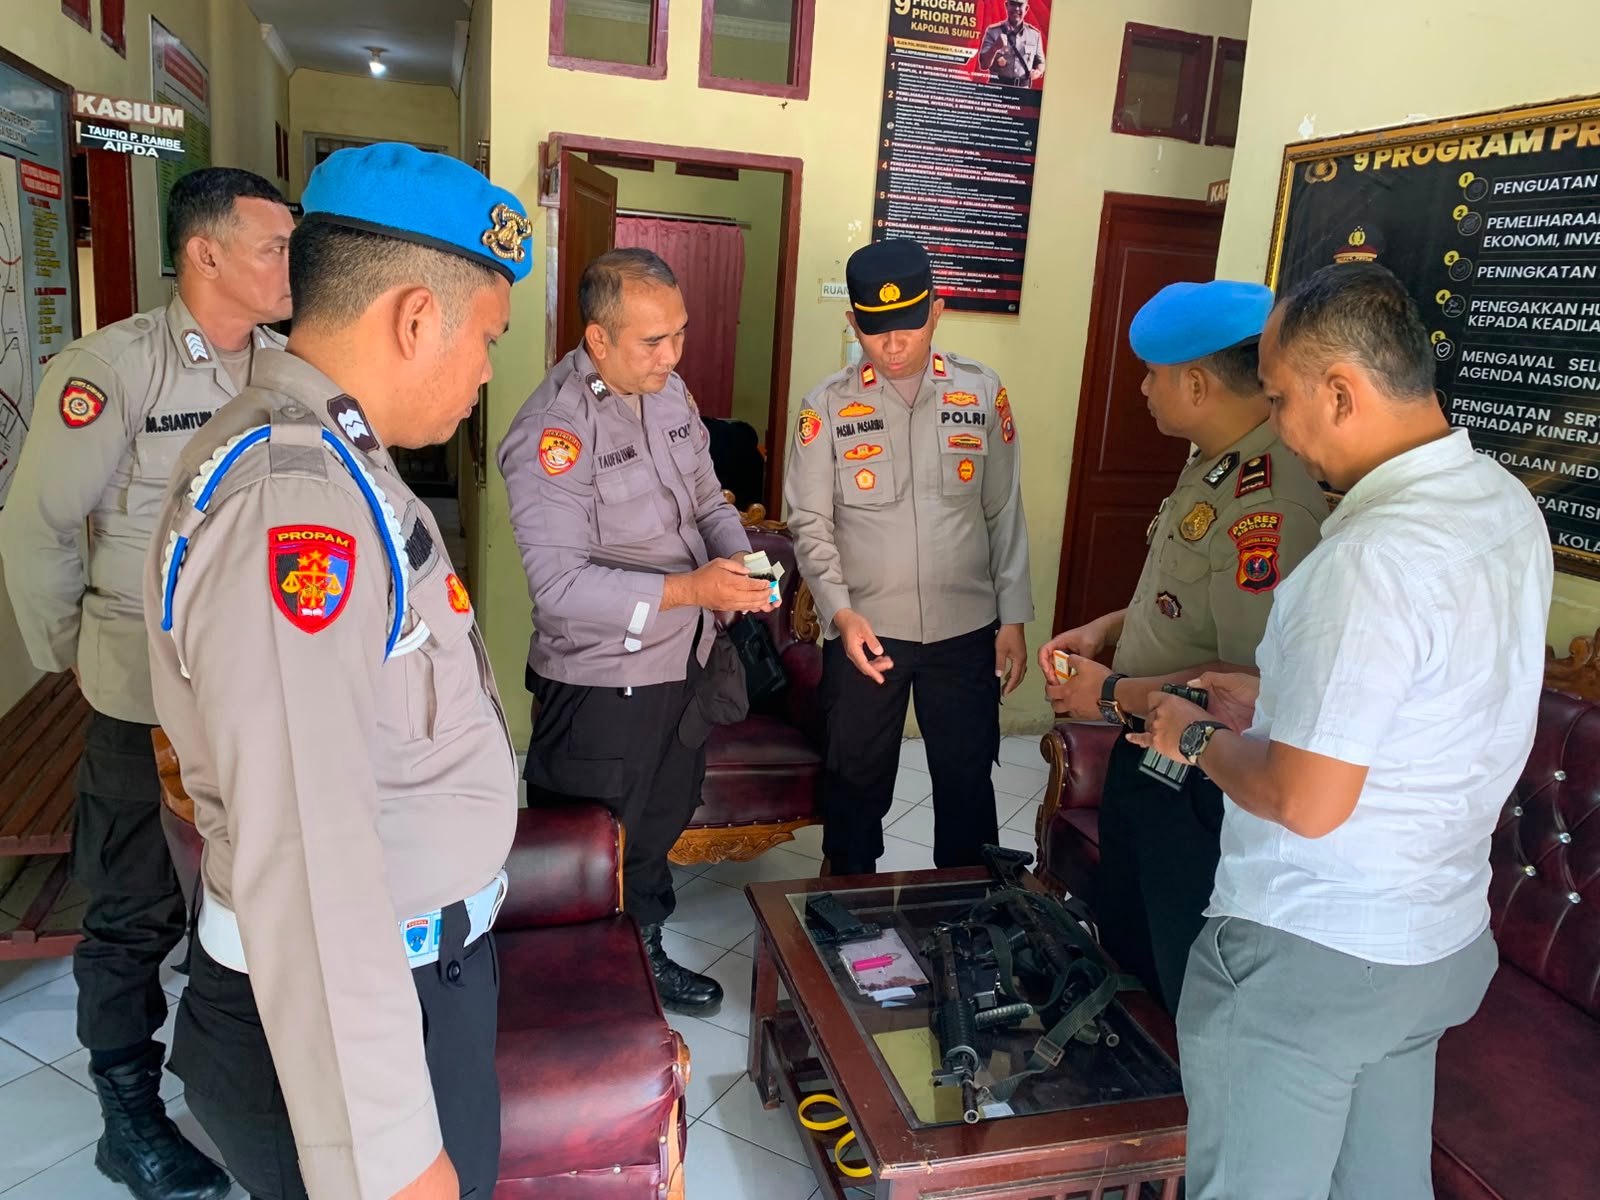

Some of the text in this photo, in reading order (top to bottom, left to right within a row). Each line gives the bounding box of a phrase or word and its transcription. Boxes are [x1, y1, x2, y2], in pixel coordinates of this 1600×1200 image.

[894, 0, 911, 15] 9
[913, 0, 975, 14] PROGRAM
[912, 8, 976, 27] PRIORITAS
[911, 22, 980, 39] KAPOLDA SUMUT
[888, 90, 894, 98] 2
[77, 94, 184, 128] KASIUM
[88, 125, 181, 149] TAUFIQ P. RAMBE
[103, 141, 159, 158] AIPDA
[1354, 122, 1600, 172] 9 PROGRAM PR
[1493, 174, 1598, 194] PENGUATAN
[1487, 212, 1600, 229] PEMELIHARAA
[1483, 234, 1560, 248] EKONOMI,
[1477, 266, 1596, 278] PENINGKATAN
[1471, 300, 1578, 316] PENEGAKKAN
[1468, 315, 1600, 332] KEPADA KEADILA
[1462, 350, 1555, 369] MENGAWAL
[1568, 358, 1600, 372] SEL
[1459, 366, 1523, 383] AGENDA
[941, 411, 985, 425] POLRI
[1452, 398, 1600, 427] PENGUATAN SER
[1451, 412, 1600, 445] TERHADAP KINERJ
[1560, 462, 1600, 479] MED
[1233, 516, 1278, 535] POLRES
[278, 531, 350, 547] PROPAM
